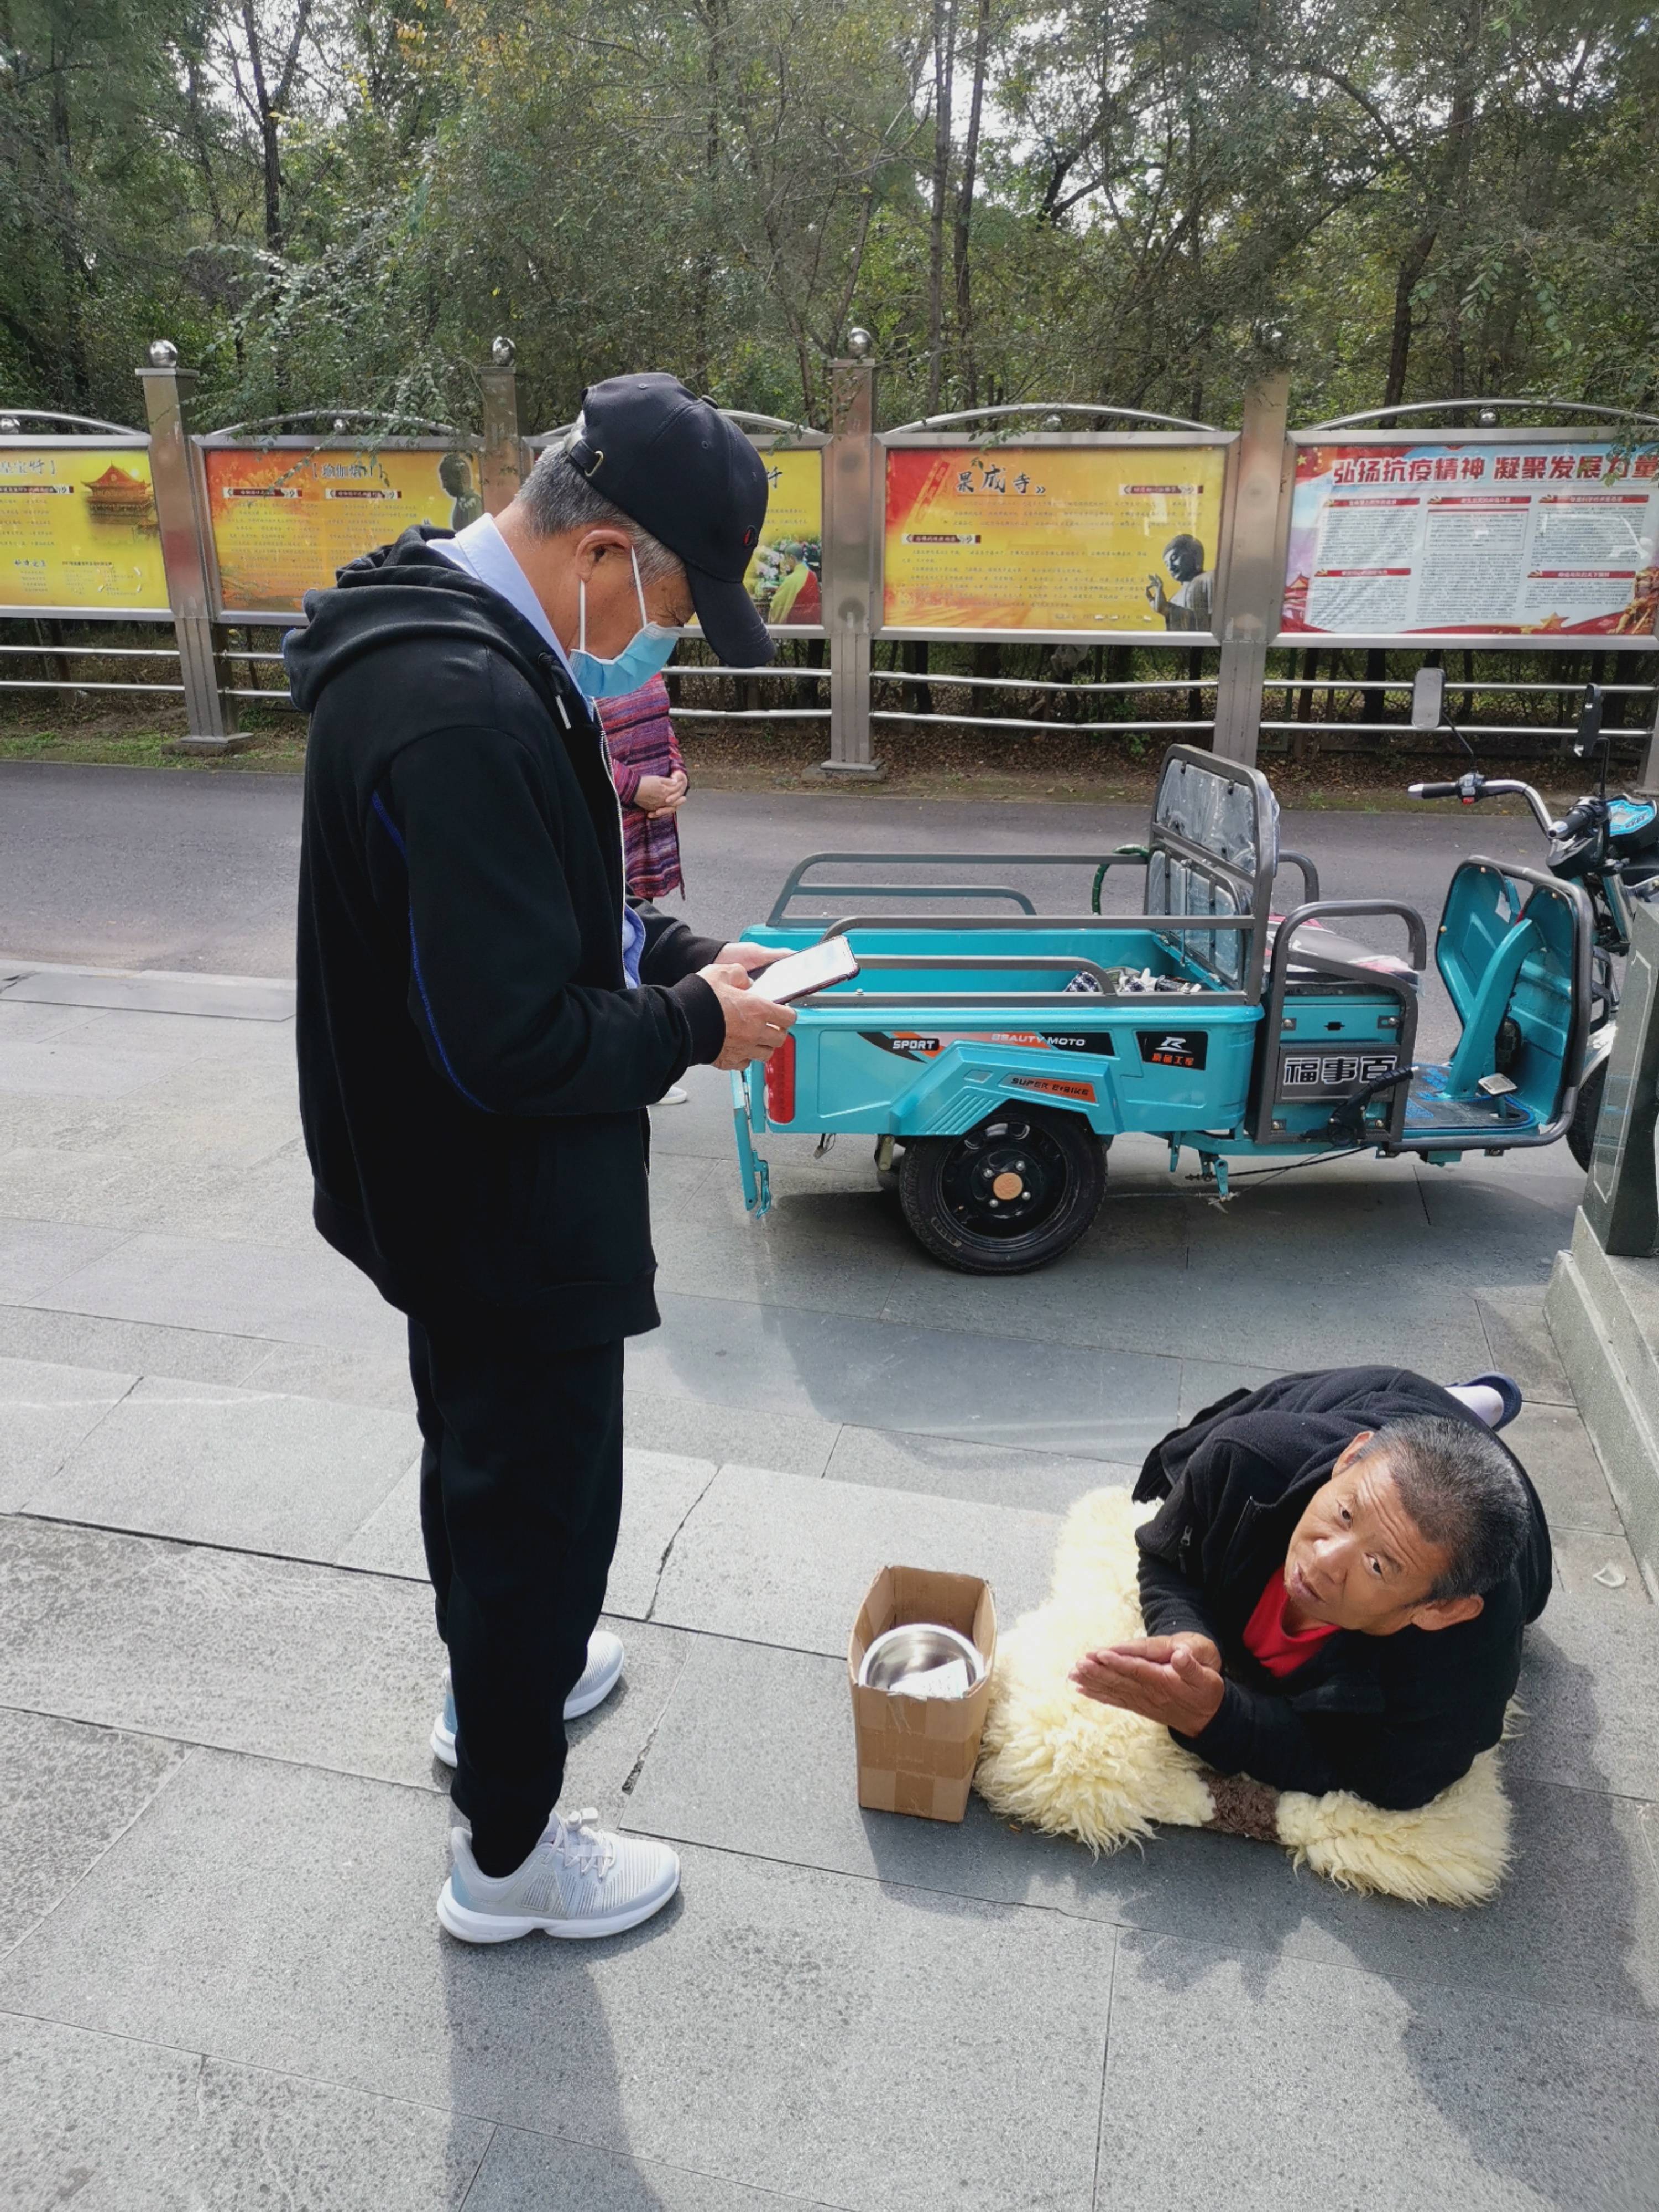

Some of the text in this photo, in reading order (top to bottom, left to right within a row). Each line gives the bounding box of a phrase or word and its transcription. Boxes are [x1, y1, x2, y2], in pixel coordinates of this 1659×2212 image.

[1333, 455, 1659, 484] 弘扬抗疫精神 凝聚发展力量
[892, 1040, 935, 1050] SPORT
[1047, 1037, 1086, 1047] MOTO
[1011, 1077, 1048, 1089] SUPER
